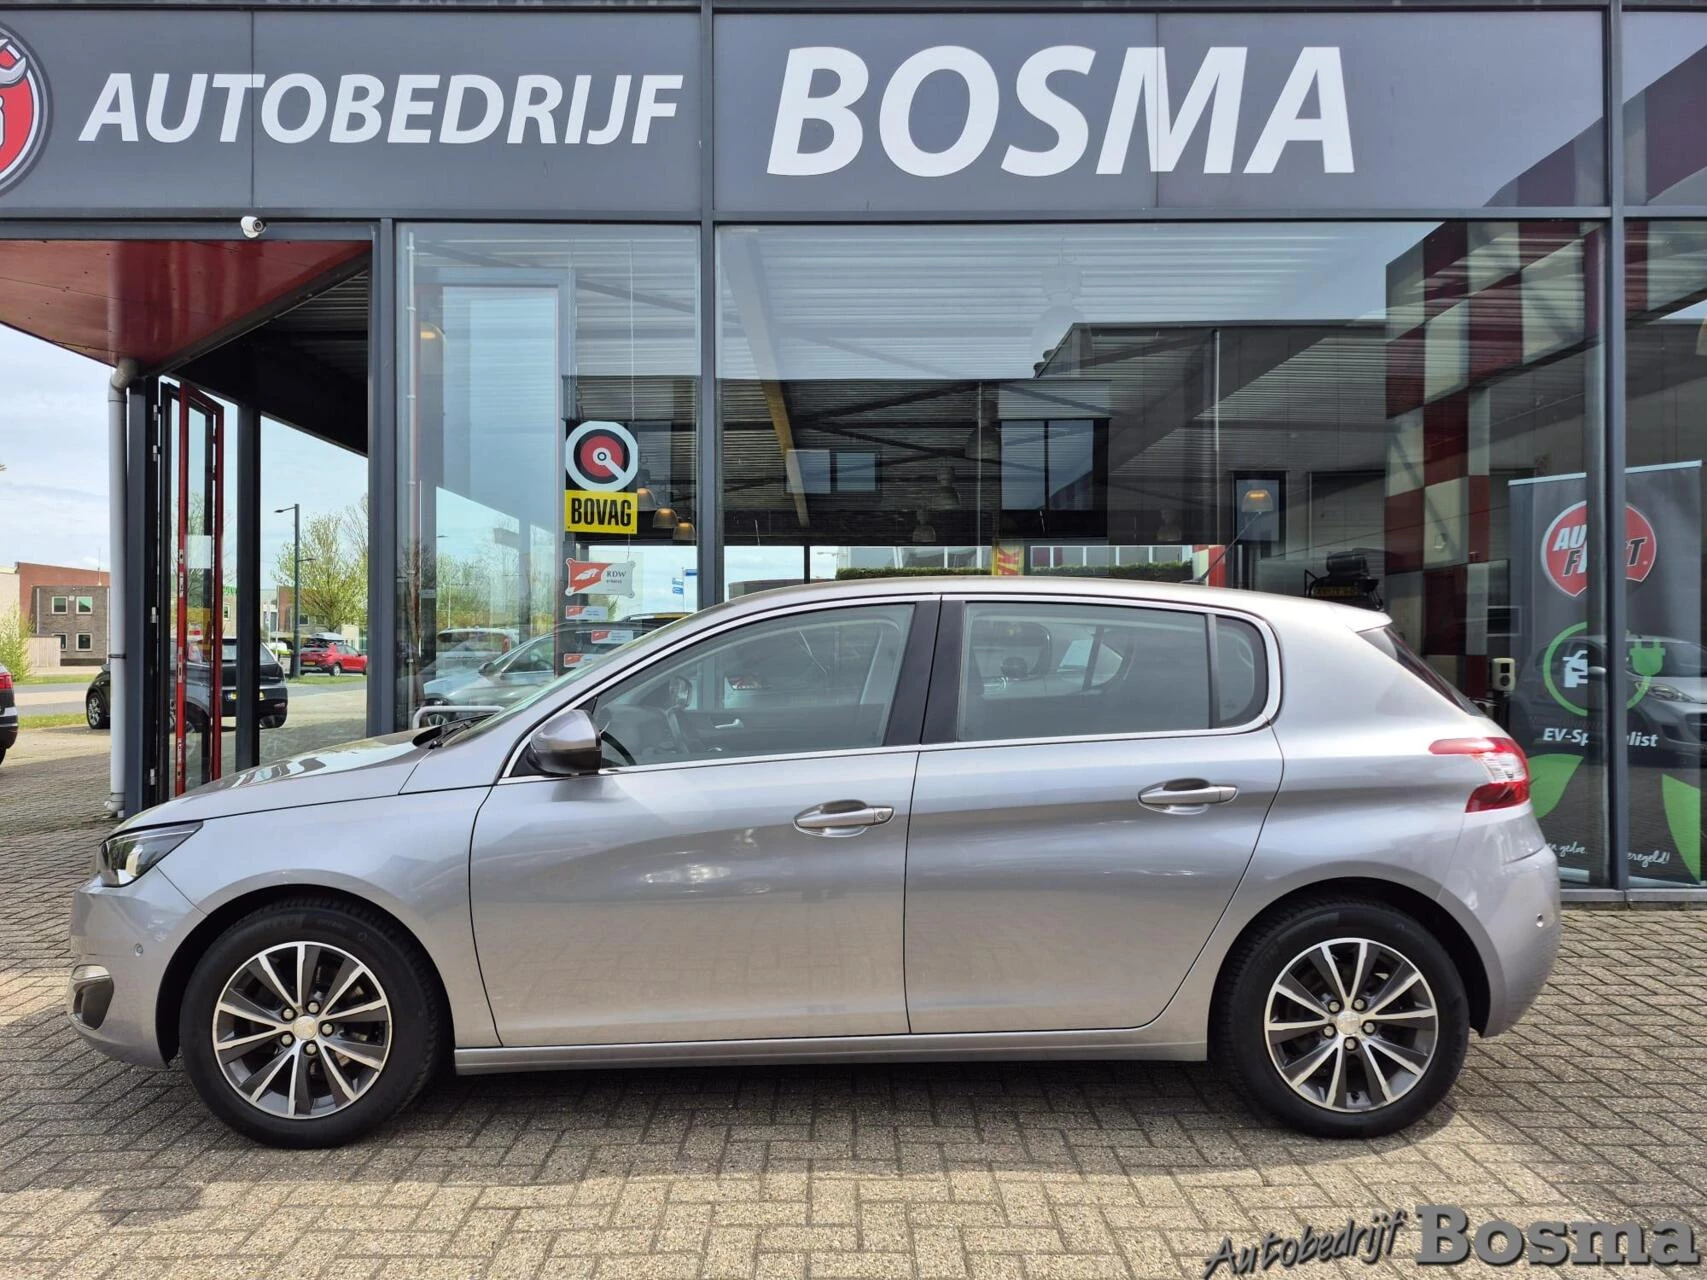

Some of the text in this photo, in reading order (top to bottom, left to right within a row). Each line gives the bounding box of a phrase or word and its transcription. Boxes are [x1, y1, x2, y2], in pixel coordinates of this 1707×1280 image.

[78, 45, 1355, 177] AUTOBEDRIJF BOSMA
[571, 498, 632, 527] BOVAG
[606, 570, 627, 578] RDW
